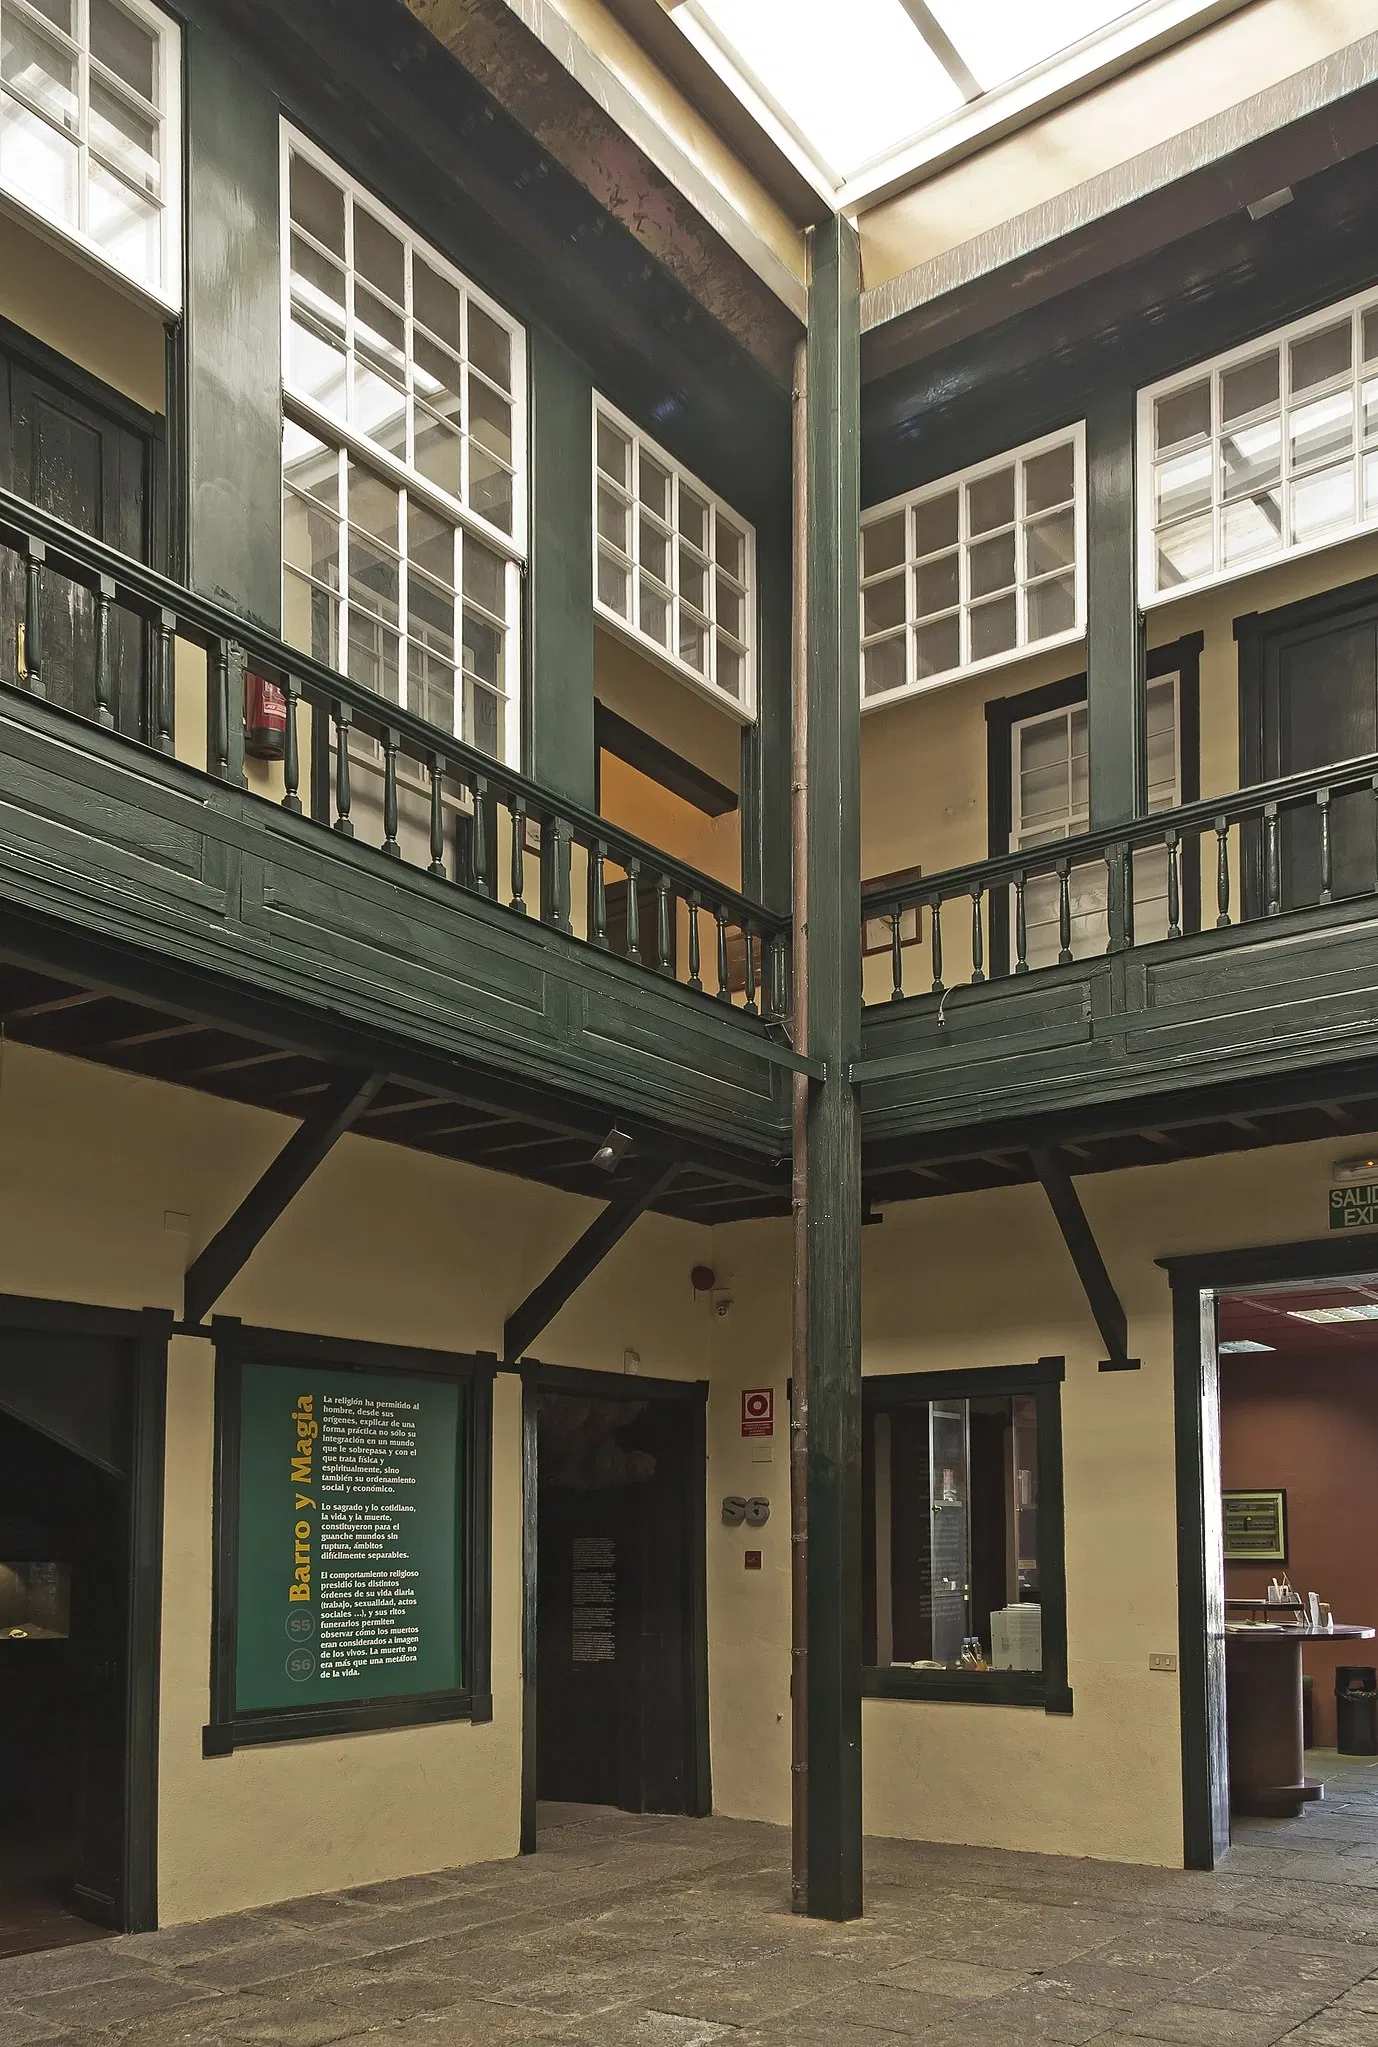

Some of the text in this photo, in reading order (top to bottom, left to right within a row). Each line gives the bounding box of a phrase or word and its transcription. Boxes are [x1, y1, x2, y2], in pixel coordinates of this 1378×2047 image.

[324, 1395, 419, 1410] La religión ha permitido al
[323, 1405, 355, 1416] hombre,
[357, 1407, 379, 1416] desde
[323, 1415, 357, 1426] orígenes,
[360, 1418, 389, 1427] explicar
[391, 1419, 400, 1427] de
[323, 1424, 345, 1433] forma
[348, 1426, 377, 1436] práctica
[390, 1429, 406, 1437] sólo
[323, 1434, 364, 1445] integración
[390, 1439, 414, 1447] mundo
[322, 1445, 337, 1453] que
[340, 1444, 346, 1452] le
[349, 1445, 387, 1456] sobrepasa
[389, 1448, 393, 1457] y
[410, 1448, 416, 1456] el
[322, 1455, 384, 1466] que trata física y
[322, 1464, 399, 1475] espiritualmente, sino
[322, 1474, 352, 1482] también
[366, 1475, 416, 1484] ordenamiento
[346, 1485, 351, 1493] y
[353, 1484, 395, 1493] económico.
[288, 1394, 318, 1603] Barro y Magia
[322, 1503, 416, 1513] Lo sagrado y lo cotidiano,
[721, 1496, 771, 1527] S6
[321, 1513, 392, 1523] la vida y la muerte,
[321, 1522, 399, 1532] constituyeron para el
[321, 1532, 398, 1542] guanche mundos sin
[321, 1542, 383, 1552] ruptura, ámbitos
[321, 1551, 409, 1561] difícilmente separables.
[321, 1569, 419, 1580] El comportamiento religioso
[321, 1579, 399, 1591] presidió los distintos
[321, 1591, 352, 1599] órdenes
[354, 1590, 364, 1598] de
[377, 1589, 392, 1597] vida
[394, 1588, 414, 1596] diaria
[321, 1598, 417, 1611] (trabajo, sexualidad, actos
[321, 1610, 352, 1619] sociales
[368, 1611, 373, 1619] y
[390, 1608, 406, 1616] ritos
[291, 1619, 311, 1632] S5
[321, 1618, 394, 1629] funerarios permiten
[321, 1626, 419, 1639] observar cómo los muertos
[320, 1641, 337, 1649] eran
[339, 1637, 387, 1647] considerados
[394, 1636, 419, 1645] imagen
[320, 1651, 330, 1659] de
[333, 1650, 344, 1658] los
[346, 1649, 368, 1657] vivos.
[370, 1647, 378, 1655] La
[380, 1645, 406, 1654] muerte
[291, 1659, 311, 1671] S6
[335, 1659, 351, 1668] más
[353, 1659, 367, 1668] que
[385, 1655, 417, 1664] metáfora
[320, 1668, 360, 1679] de la vida.
